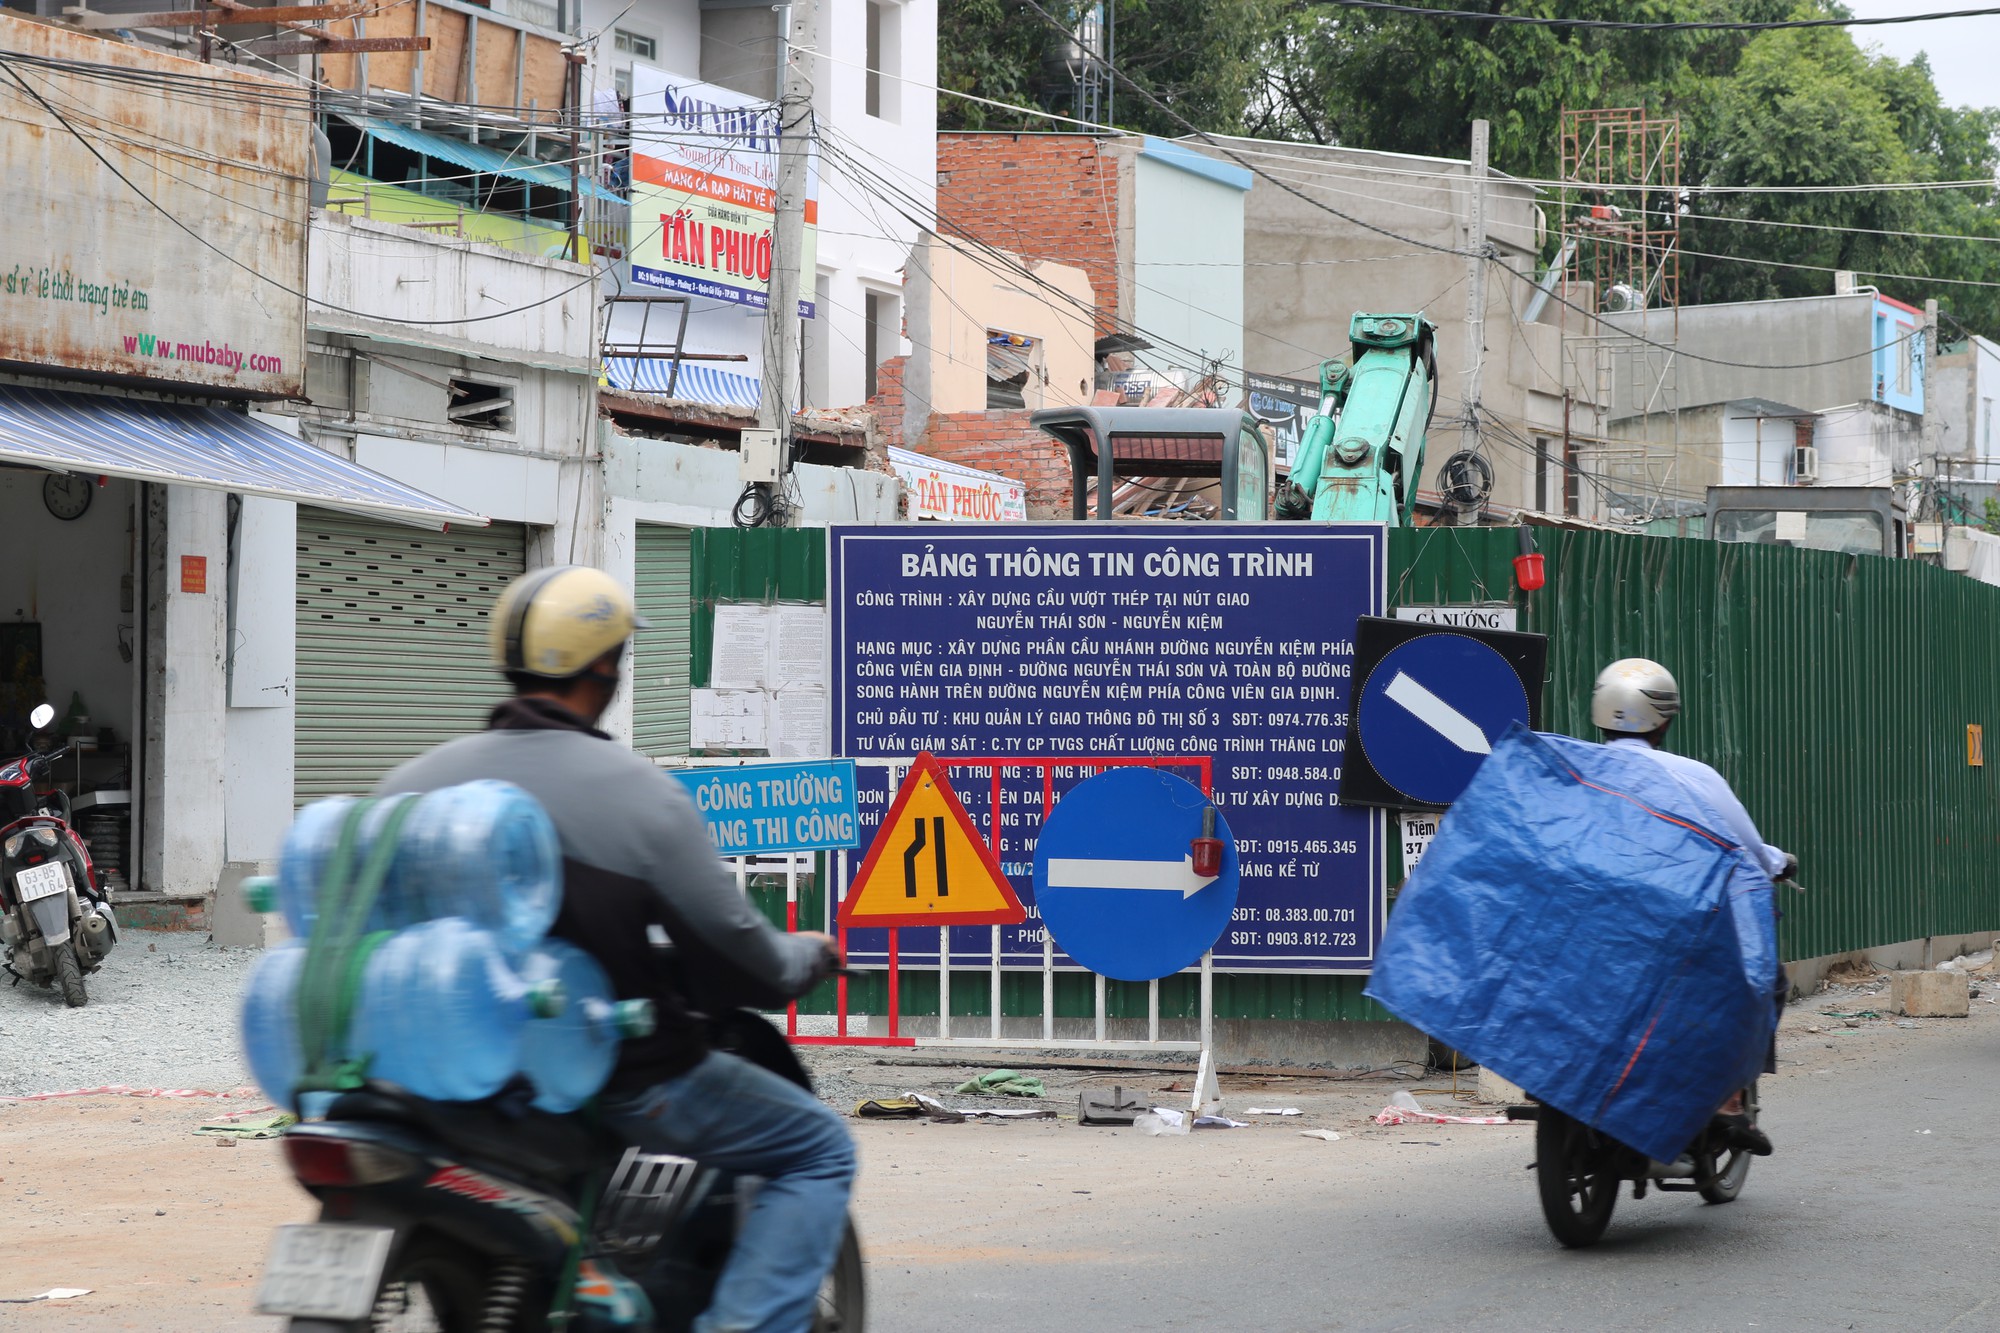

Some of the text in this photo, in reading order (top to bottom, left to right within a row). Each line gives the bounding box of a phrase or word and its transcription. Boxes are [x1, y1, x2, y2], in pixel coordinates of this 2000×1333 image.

[729, 156, 751, 175] Your
[665, 169, 693, 188] MANG
[711, 182, 730, 200] RẠP
[733, 184, 751, 203] HÁT
[660, 209, 773, 284] TẤN PHƯỚ
[52, 270, 74, 301] thời
[78, 279, 109, 315] trang
[112, 280, 129, 308] trẻ
[131, 289, 149, 311] em
[952, 482, 1002, 521] PHƯỚC
[902, 544, 1312, 577] BẢNG THÔNG TIN CÔNG TRÌNH
[857, 588, 1249, 608] CÔNG TRÌNH XÂY DỰNG CẦU VƯỢT THÉP TẠI NÚT GIAO
[977, 611, 1222, 631] NGUYỄN THÁI SƠN NGUYỄN KIỆM
[1443, 609, 1500, 628] NƯỚNG
[857, 637, 1354, 657] HẠNG MỤC XÂY DỰNG PHẦN CẦU NHÁNH ĐƯỜNG NGUYỄN KIỆM PHÍA
[857, 658, 1350, 679] CÔNG VIÊN GIA ĐỊNH ĐƯỜNG NGUYỄN THÁI SƠN VÀ TOÀN BỘ ĐƯỜNG
[857, 680, 1339, 701] SONG HÀNH TRÊN ĐƯỜNG NGUYỄN KIỆM PHÍA CÔNG VIÊN GIA ĐỊNH.
[857, 707, 1348, 728] CHỦ ĐẦU TƯ KHU QUẢN LÝ GIAO THÔNG ĐÔ THỊ SỐ 3 SĐT: 0974.776.35
[857, 733, 1346, 753] TƯ VẤN GIÁM SÁT C.TY CP TVGS CHẤT LƯỢNG CÔNG TRÌNH THĂNG LON
[1036, 766, 1073, 779] ĐNG
[1232, 767, 1261, 779] SĐT:
[696, 771, 843, 812] CÔNG TRƯỜNG
[858, 788, 884, 805] ĐƠN
[988, 789, 1017, 804] LÊN
[1024, 789, 1060, 804] DAH
[1231, 791, 1248, 805] TƯ
[1253, 790, 1279, 805] XÂY
[1286, 791, 1322, 808] DỰNG
[706, 819, 748, 848] ANG
[752, 816, 789, 845] THI
[795, 807, 853, 843] CÔNG
[858, 810, 879, 825] KHÍ
[983, 813, 1018, 826] CNG
[1025, 814, 1041, 826] TY
[1406, 820, 1436, 839] Tiệm
[1268, 840, 1356, 853] 0915.465.345
[24, 864, 56, 885] 63-B5
[1279, 858, 1296, 877] KỂ
[1302, 861, 1319, 877] TỪ
[1232, 908, 1355, 922] SĐT: 08.383.00.701
[1231, 932, 1261, 945] SĐT:
[1267, 933, 1356, 946] 0903.812.723
